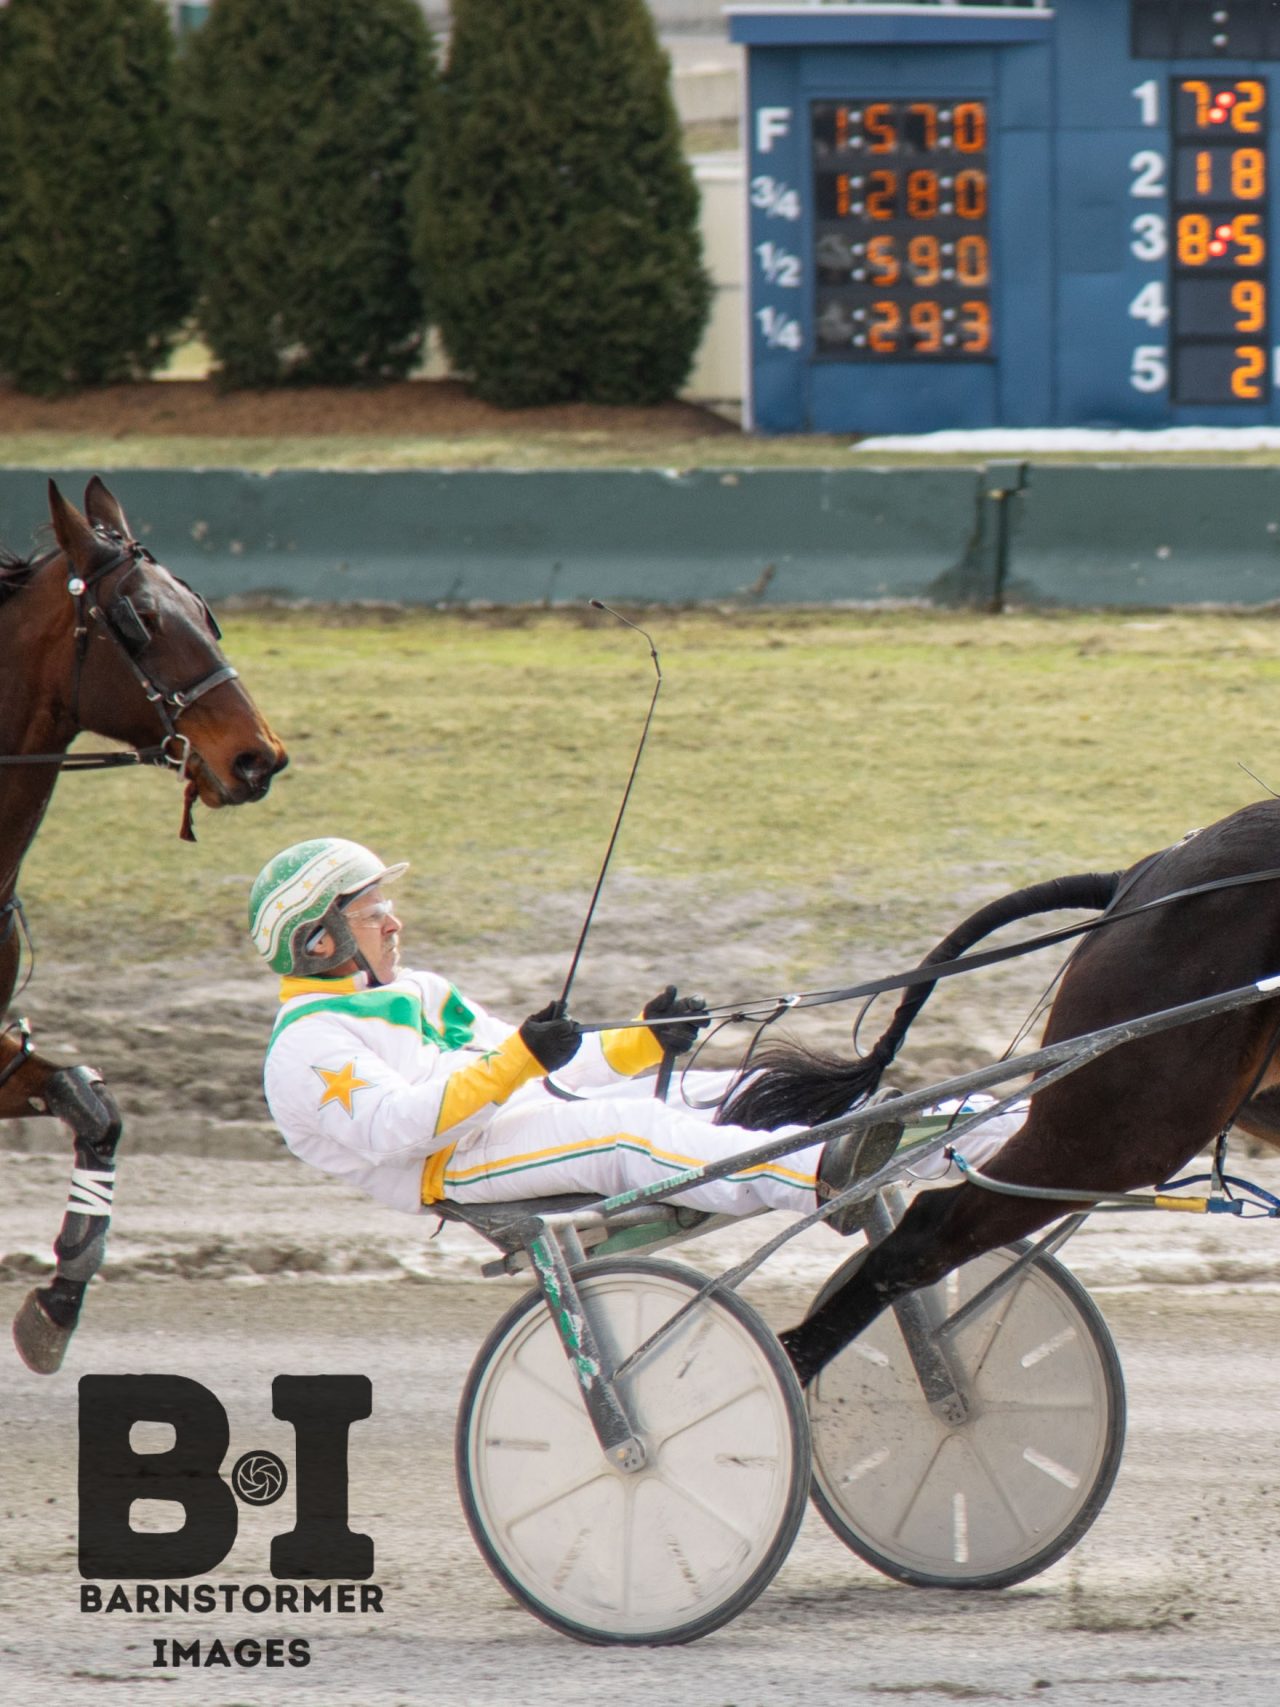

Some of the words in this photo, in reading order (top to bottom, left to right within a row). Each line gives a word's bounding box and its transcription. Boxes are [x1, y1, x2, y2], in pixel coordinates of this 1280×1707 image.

[1131, 80, 1160, 126] 1
[756, 107, 792, 153] F
[1129, 150, 1166, 198] 2
[1195, 147, 1265, 200] 18
[1130, 213, 1167, 261] 3
[1128, 280, 1169, 327] 4
[1231, 280, 1265, 332] 9
[1130, 346, 1167, 392] 5
[1231, 345, 1265, 399] 2
